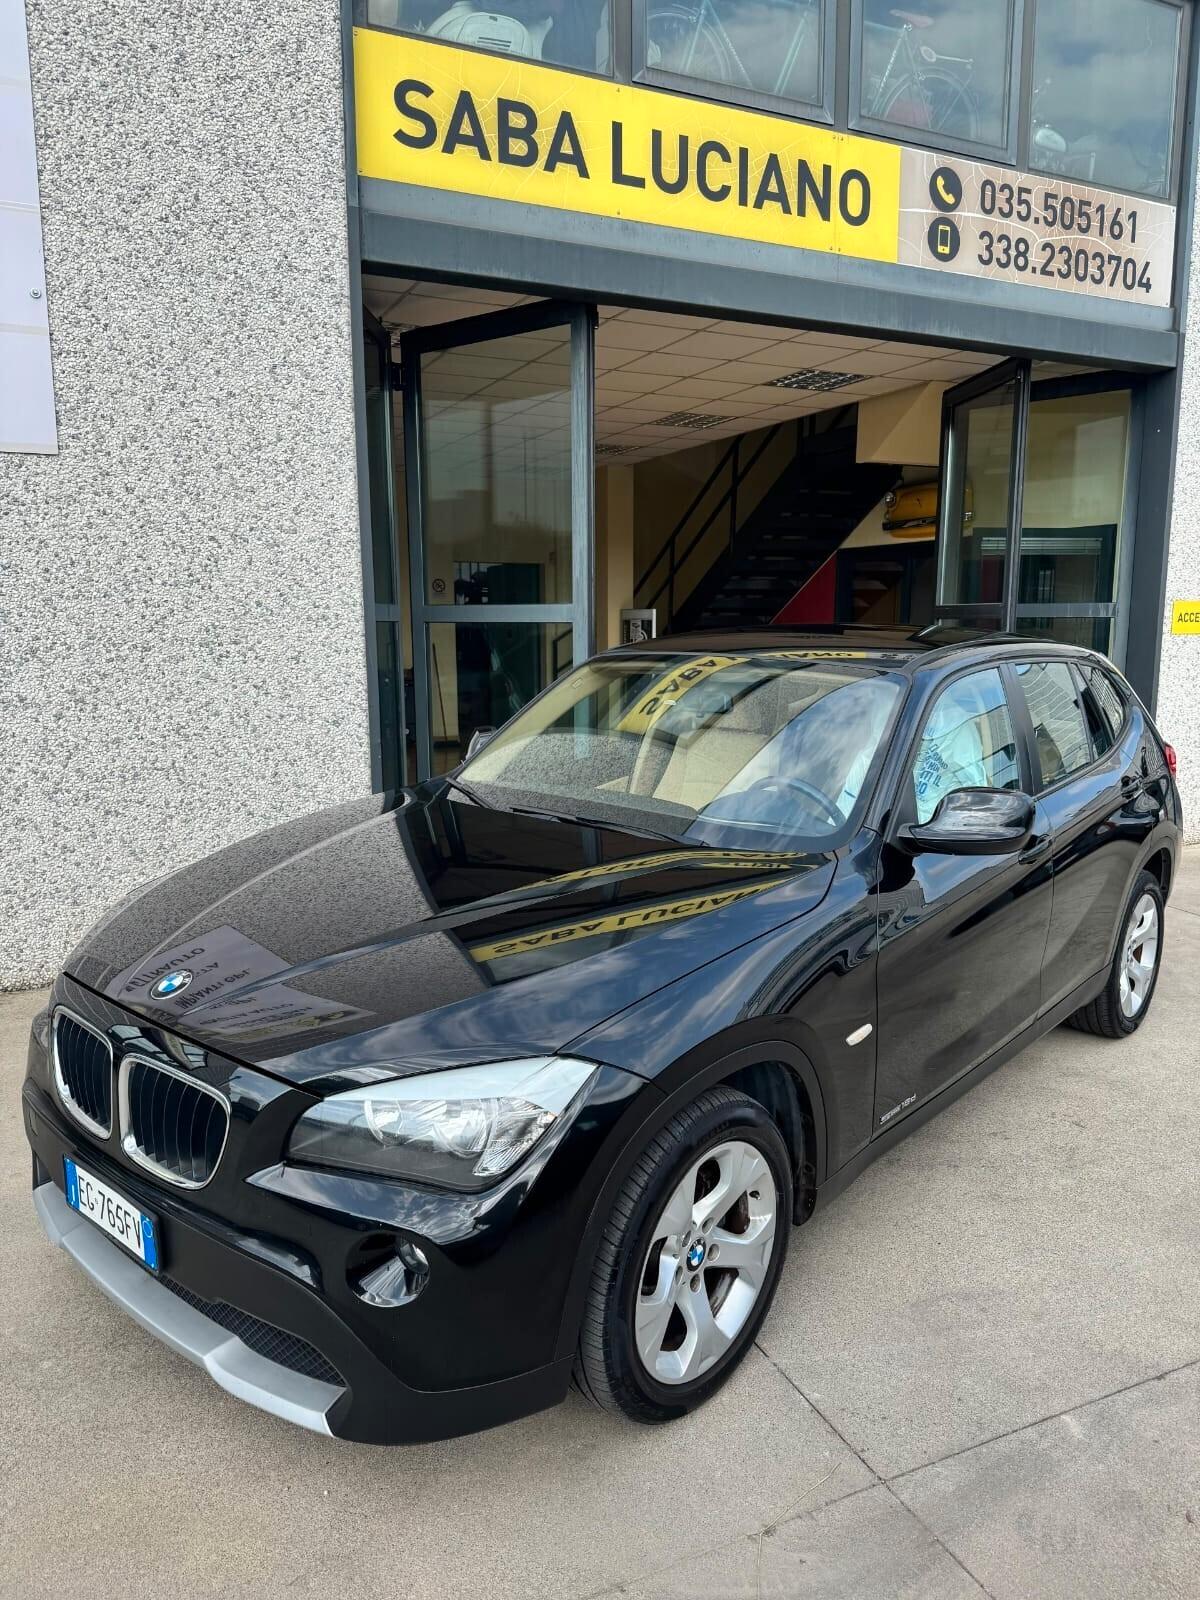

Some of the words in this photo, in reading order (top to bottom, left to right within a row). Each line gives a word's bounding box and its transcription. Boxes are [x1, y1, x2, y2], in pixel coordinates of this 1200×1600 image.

[392, 78, 591, 180] SABA
[611, 121, 872, 228] LUCIANO
[980, 178, 1138, 244] 035.505161
[977, 230, 1152, 294] 338.2303704
[1178, 612, 1200, 623] ACCE
